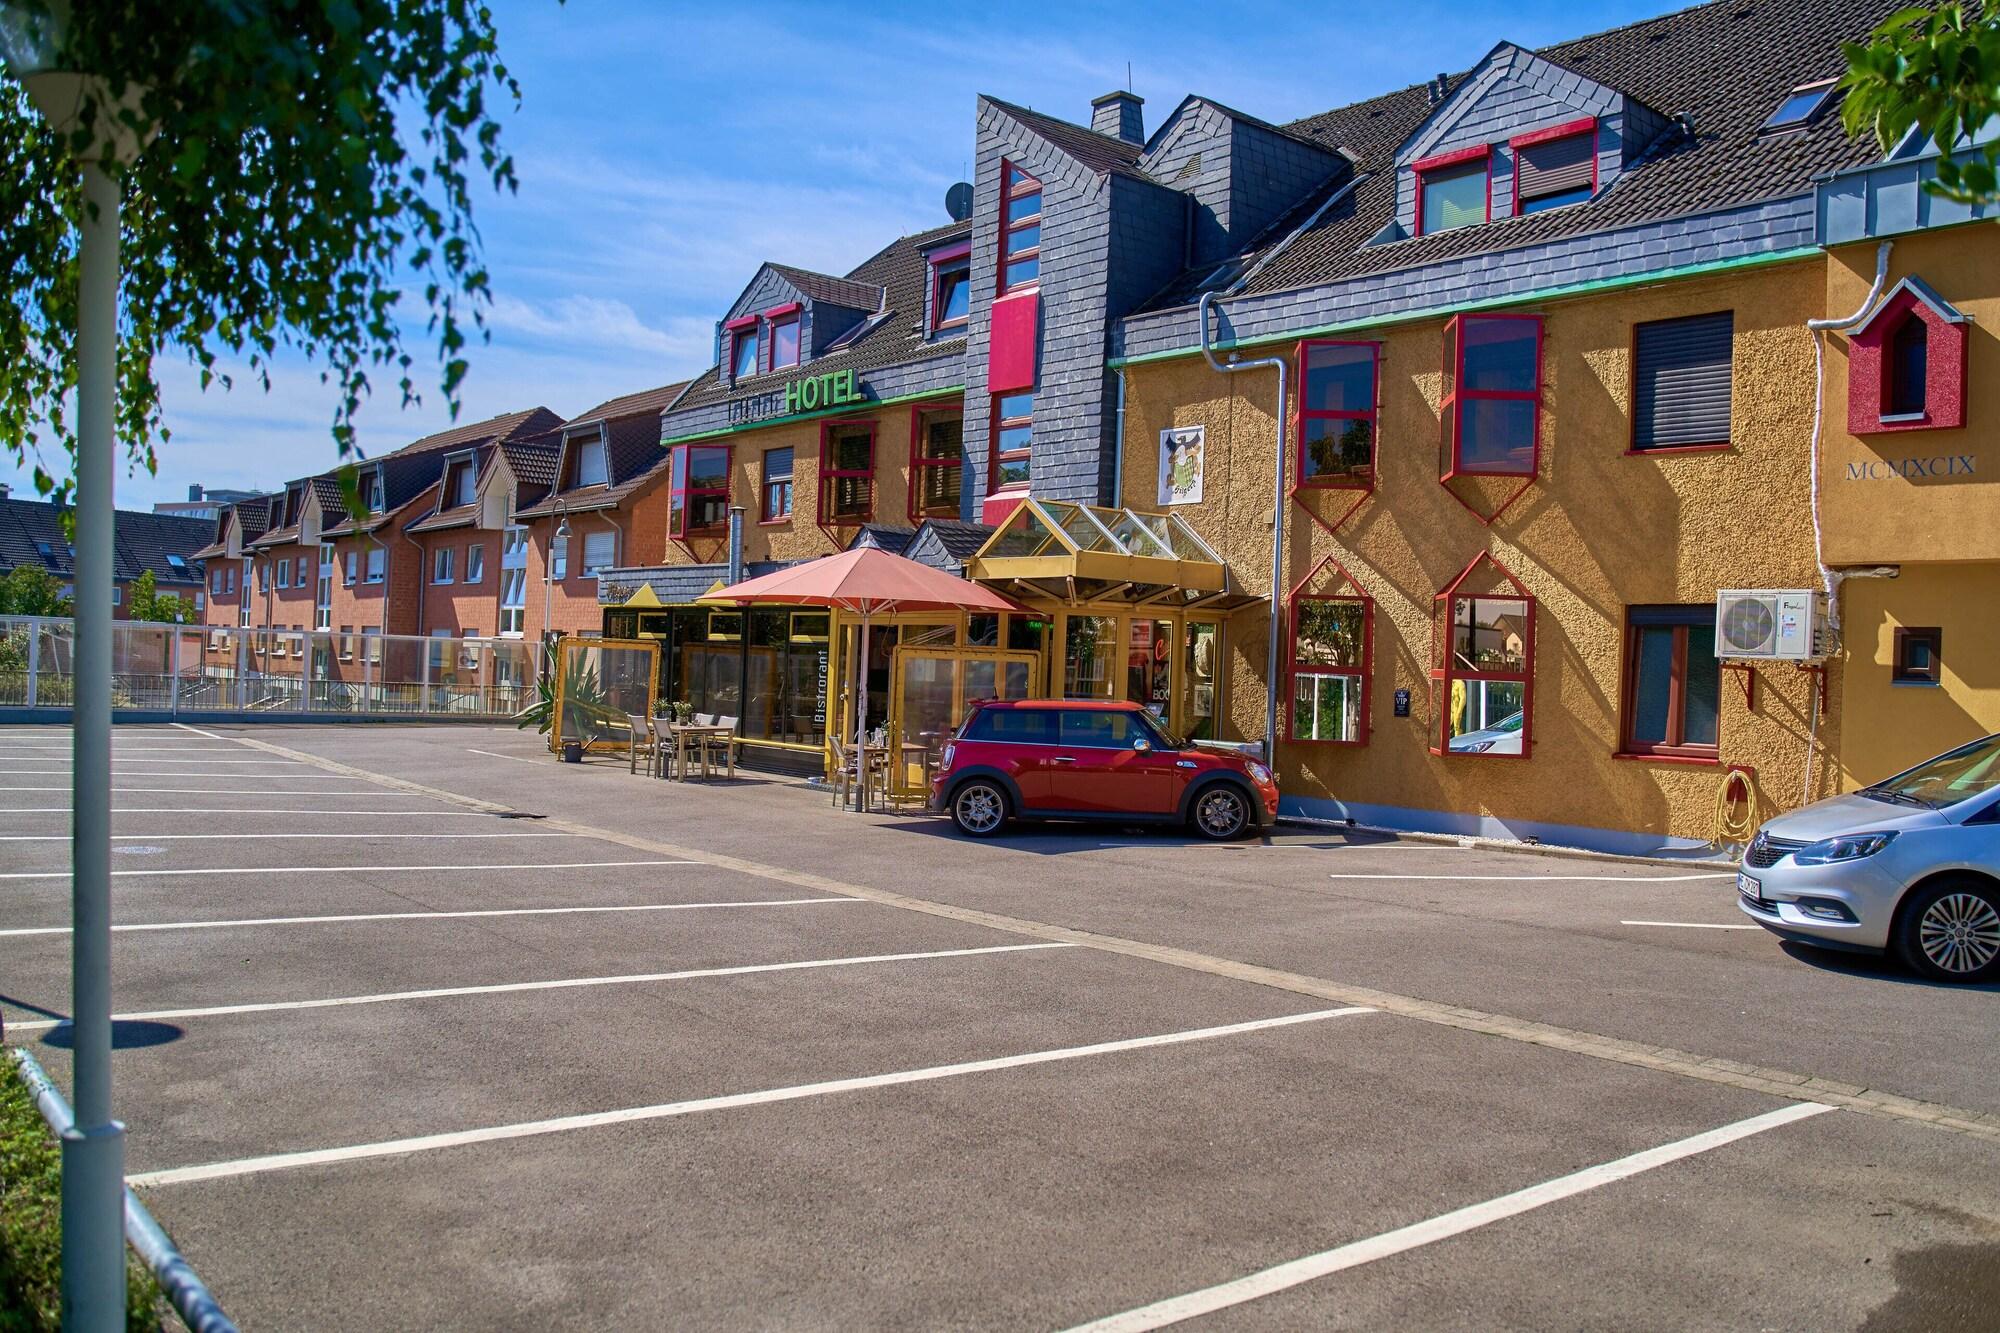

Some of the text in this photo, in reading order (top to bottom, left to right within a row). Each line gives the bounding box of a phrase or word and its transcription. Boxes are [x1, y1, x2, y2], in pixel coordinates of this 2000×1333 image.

[785, 368, 861, 413] HOTEL
[1846, 455, 1975, 480] MCMXCIX
[814, 650, 828, 722] Bistrorant
[1395, 697, 1407, 705] VIP
